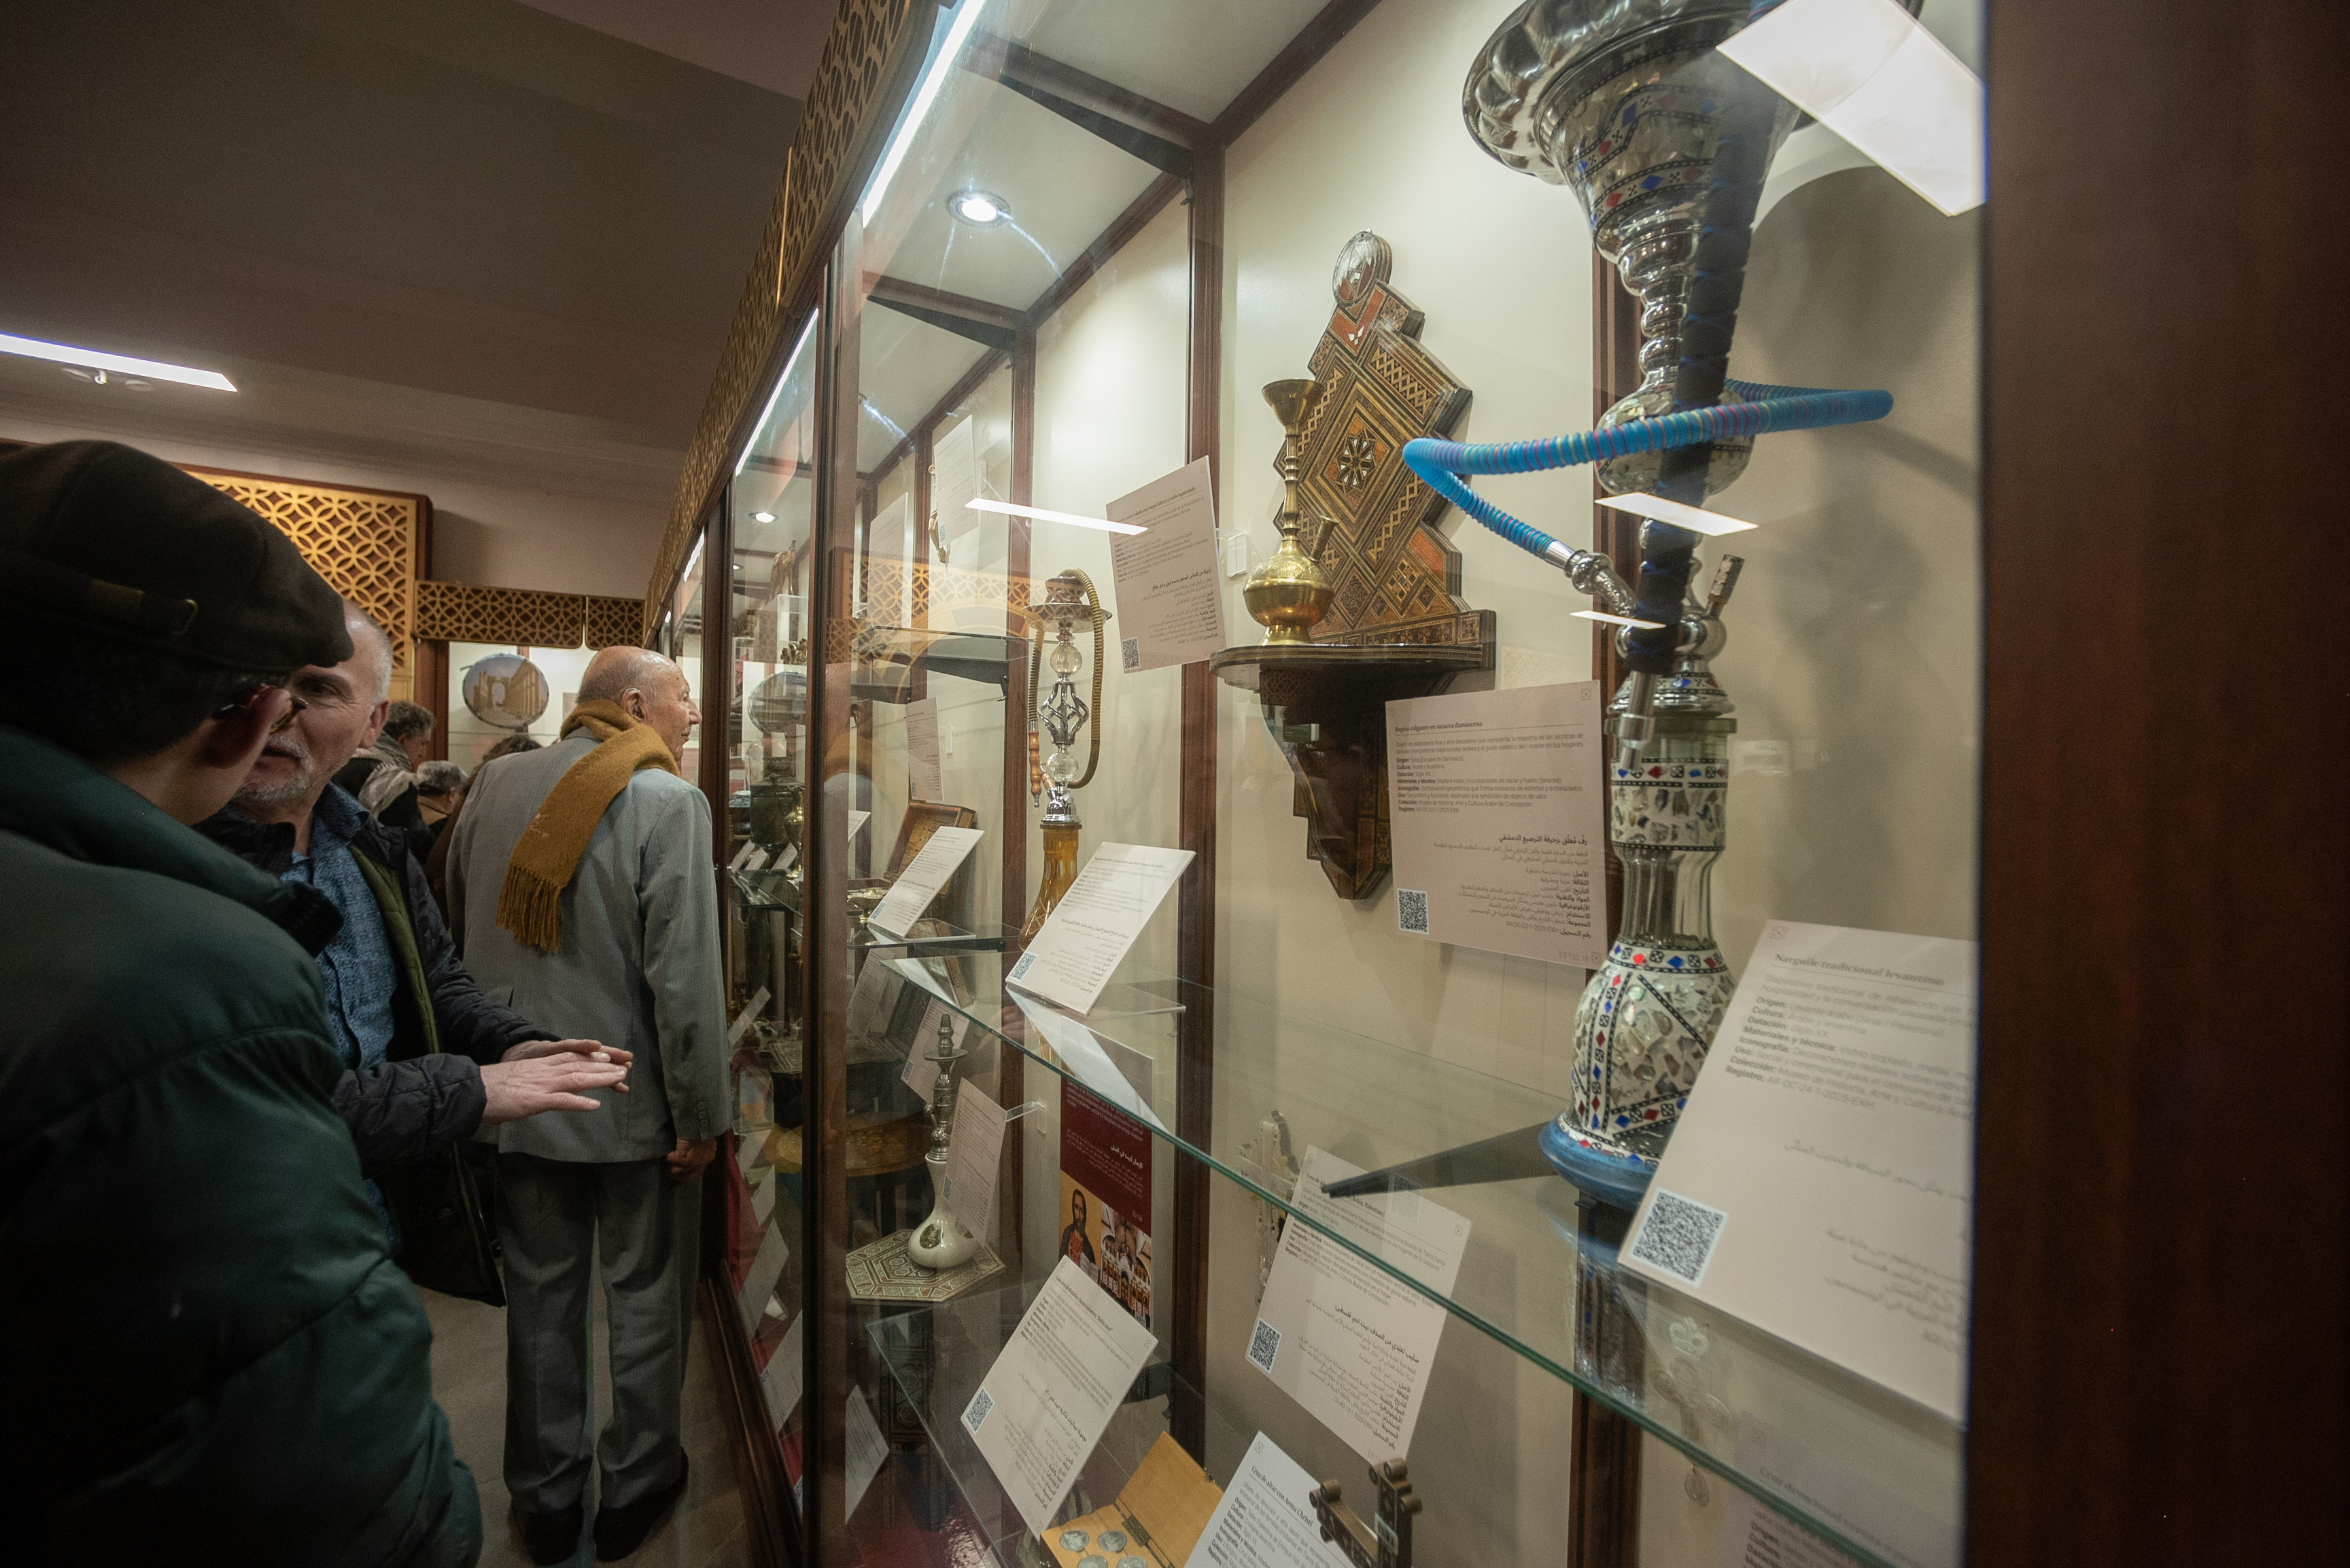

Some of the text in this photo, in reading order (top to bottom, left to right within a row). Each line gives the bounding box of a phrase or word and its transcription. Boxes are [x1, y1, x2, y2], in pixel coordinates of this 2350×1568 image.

[1177, 485, 1195, 498] Segmentado
[1410, 724, 1429, 732] colgante
[1455, 720, 1483, 729] damascena
[1773, 953, 1947, 986] Narguile tradicional levantino
[1815, 983, 1865, 997] tradicional
[1751, 1006, 1787, 1018] Cultura:
[1755, 996, 1788, 1010] Origen:
[1746, 1015, 1790, 1030] Datación:
[1738, 1035, 1792, 1054] Iconografía:
[1742, 1025, 1791, 1041] Materiales
[1799, 1036, 1839, 1051] técnica:
[1734, 1045, 1755, 1056] Uso:
[1729, 1055, 1778, 1072] Colección:
[1724, 1065, 1767, 1083] Registro:
[1307, 1172, 1315, 1181] Cruz
[1364, 1202, 1385, 1218] Palestina)
[1251, 1465, 1314, 1527] Cruz de altar con Arma Christi
[1226, 1510, 1244, 1530] Datación:
[1230, 1503, 1245, 1520] Cultura:
[1242, 1480, 1256, 1495] Objeto
[1254, 1491, 1261, 1500] de
[1260, 1497, 1277, 1516] devoción
[1279, 1516, 1290, 1528] arte
[1288, 1525, 1301, 1539] sacro
[1299, 1537, 1309, 1548] que
[1233, 1495, 1248, 1514] Origen:
[1246, 1508, 1258, 1522] Taller
[1256, 1518, 1274, 1538] Palestina
[1272, 1534, 1279, 1544] de
[1277, 1539, 1294, 1559] Enrique
[1239, 1487, 1256, 1506] artesanal
[1254, 1502, 1261, 1511] de
[1264, 1512, 1281, 1531] familias
[1279, 1527, 1298, 1548] cristianas
[1302, 1550, 1315, 1565] Tierra
[1215, 1531, 1224, 1544] Uso:
[1217, 1524, 1241, 1550] Iconografía:
[1222, 1517, 1242, 1539] Materiales
[1243, 1538, 1259, 1557] técnica:
[1206, 1546, 1224, 1566] Registro:
[1211, 1538, 1230, 1561] Colección:
